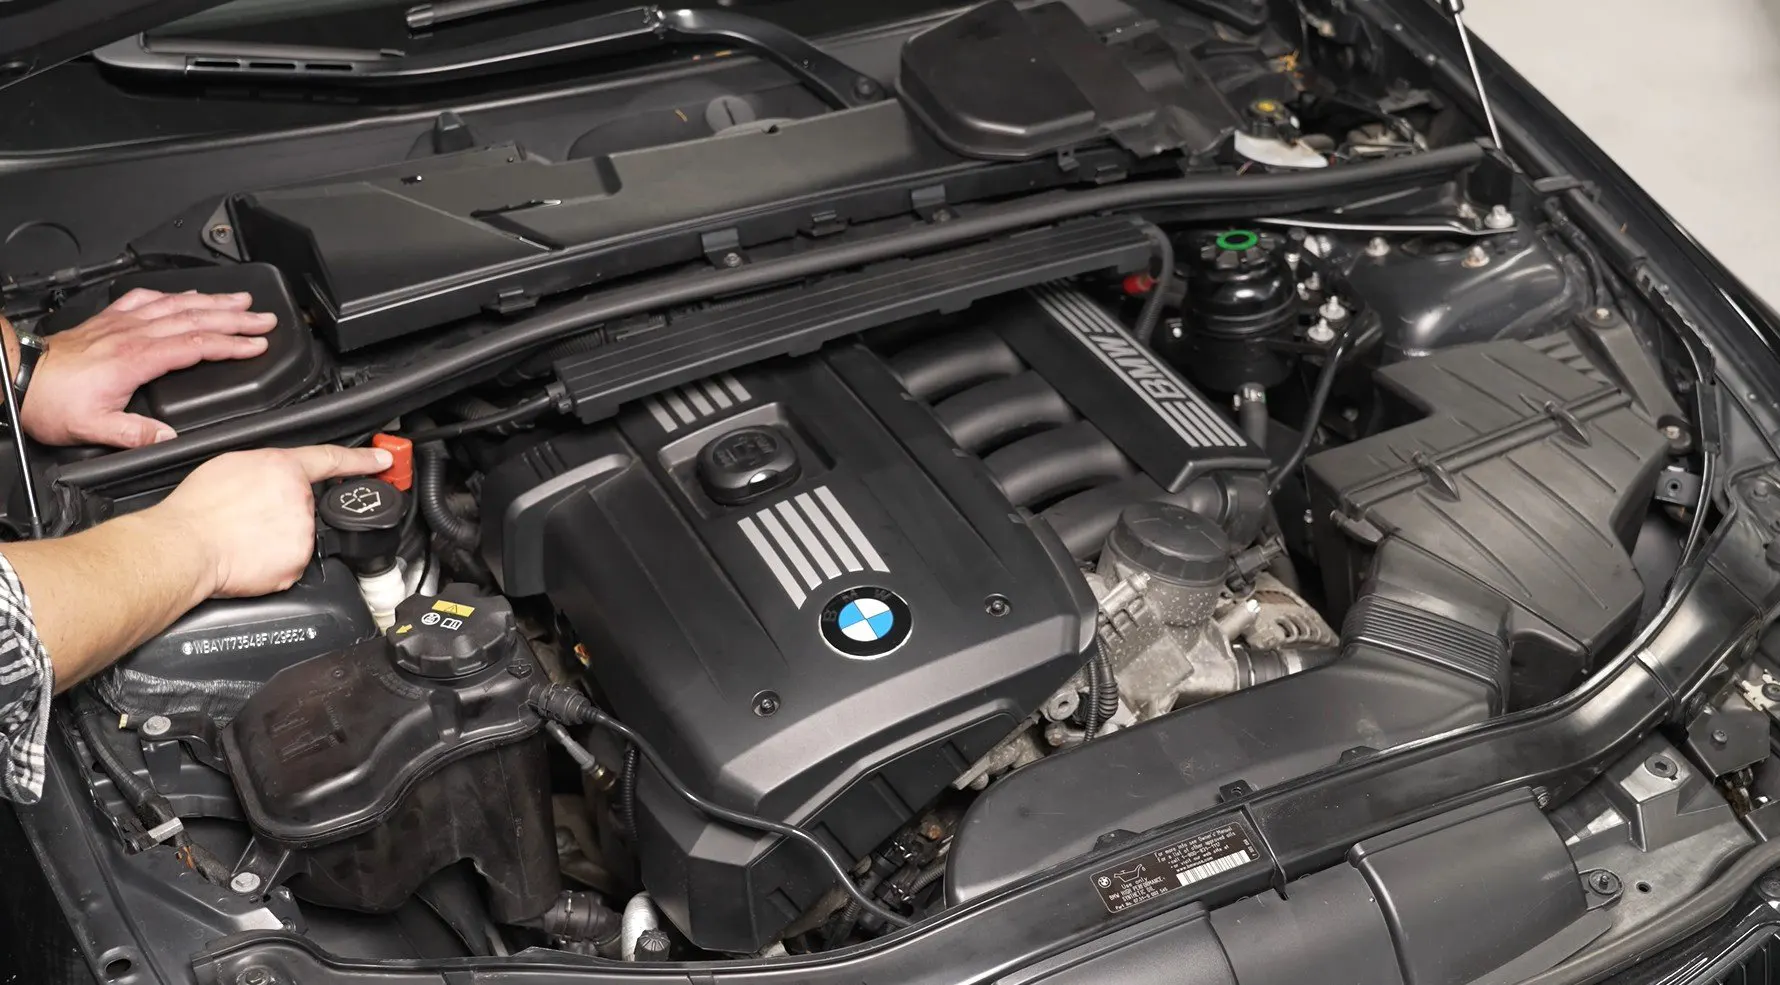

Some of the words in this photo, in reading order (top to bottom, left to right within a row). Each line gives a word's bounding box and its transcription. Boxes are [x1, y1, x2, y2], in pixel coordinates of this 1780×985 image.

[1089, 335, 1187, 400] BMW
[193, 628, 305, 655] WBAVT73548FV29552
[1190, 842, 1203, 850] other
[1204, 835, 1225, 846] approved
[1135, 876, 1148, 885] only
